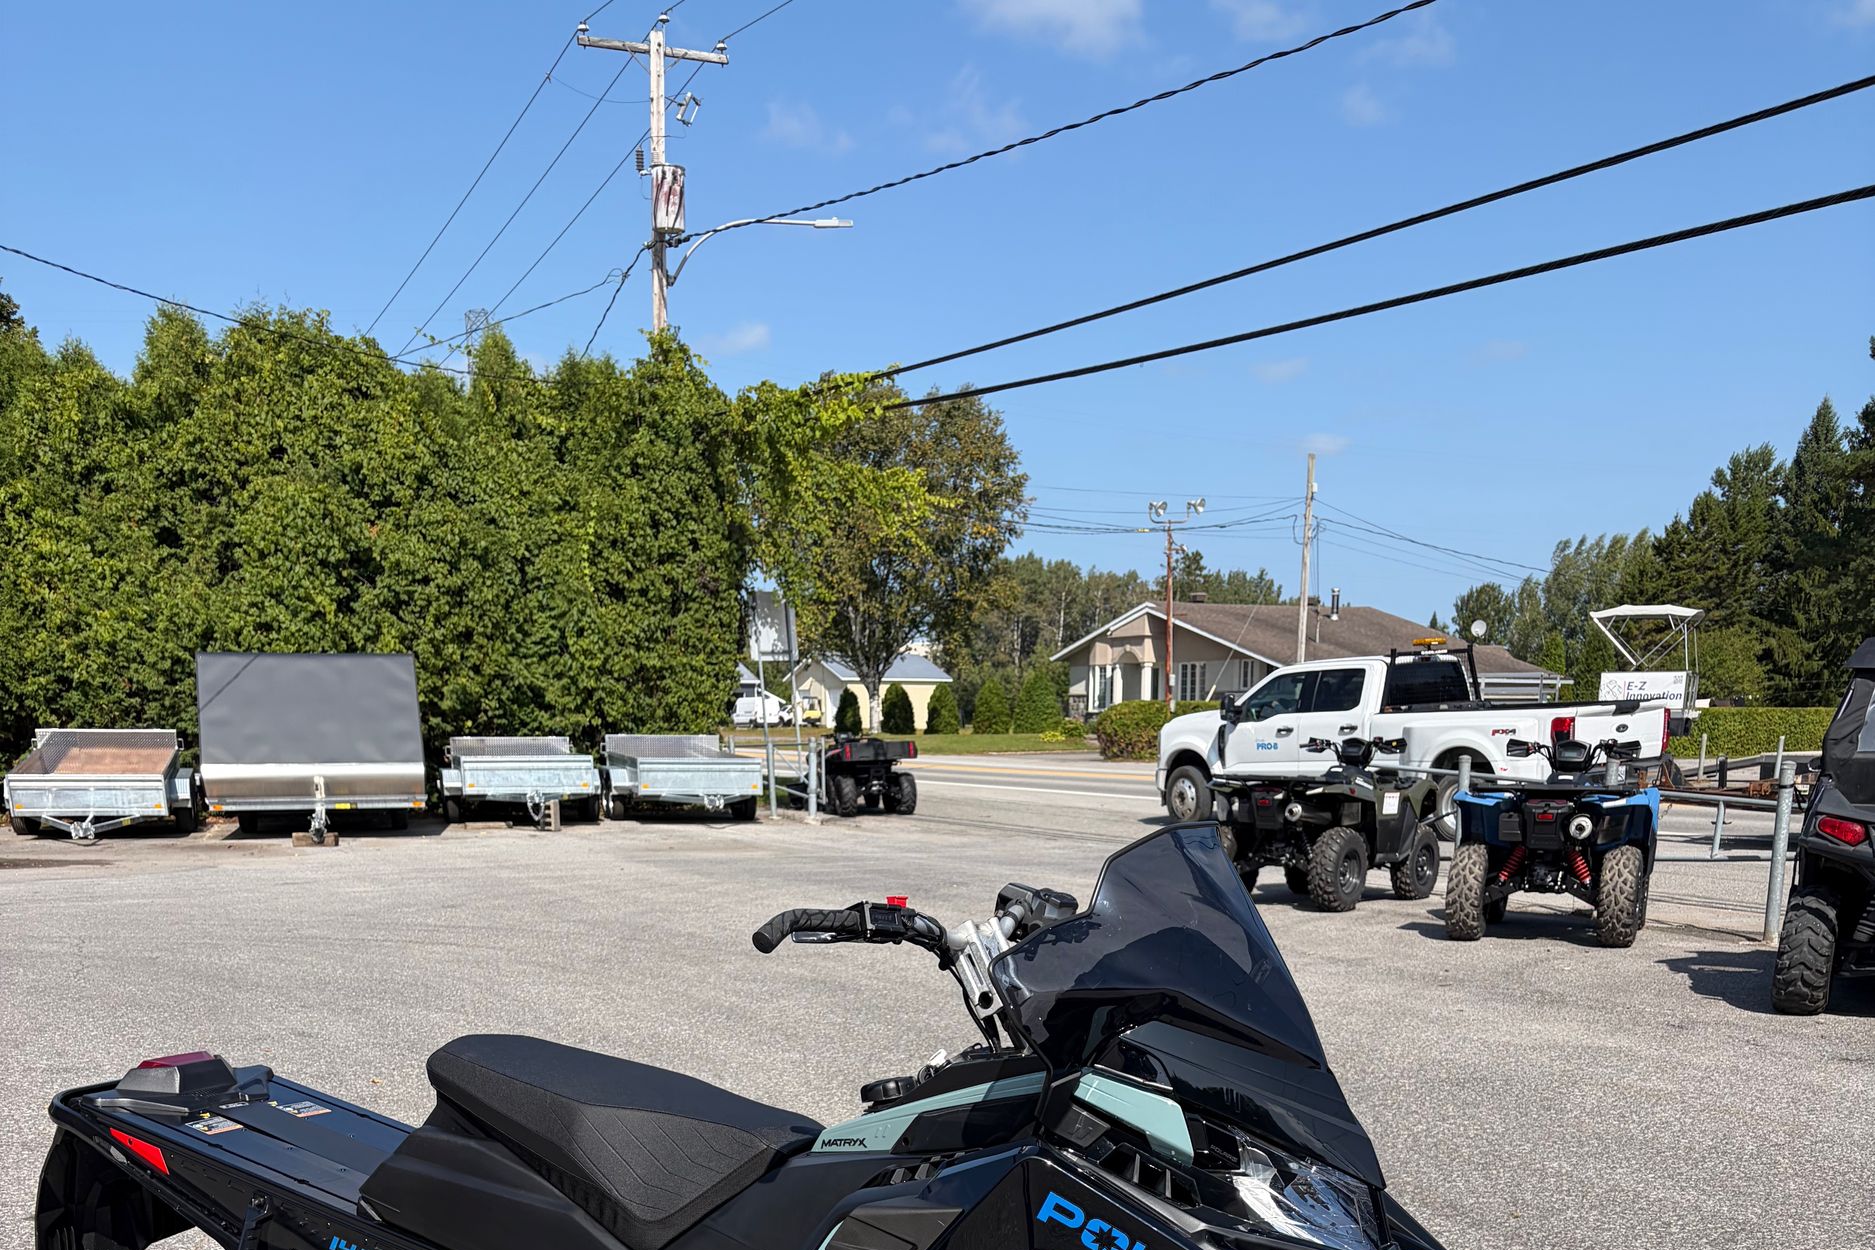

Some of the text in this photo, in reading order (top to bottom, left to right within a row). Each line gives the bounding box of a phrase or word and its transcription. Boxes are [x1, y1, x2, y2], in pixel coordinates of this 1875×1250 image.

[1627, 681, 1647, 690] E-Z
[1626, 690, 1682, 701] Innovation
[821, 1137, 867, 1149] MATRYX
